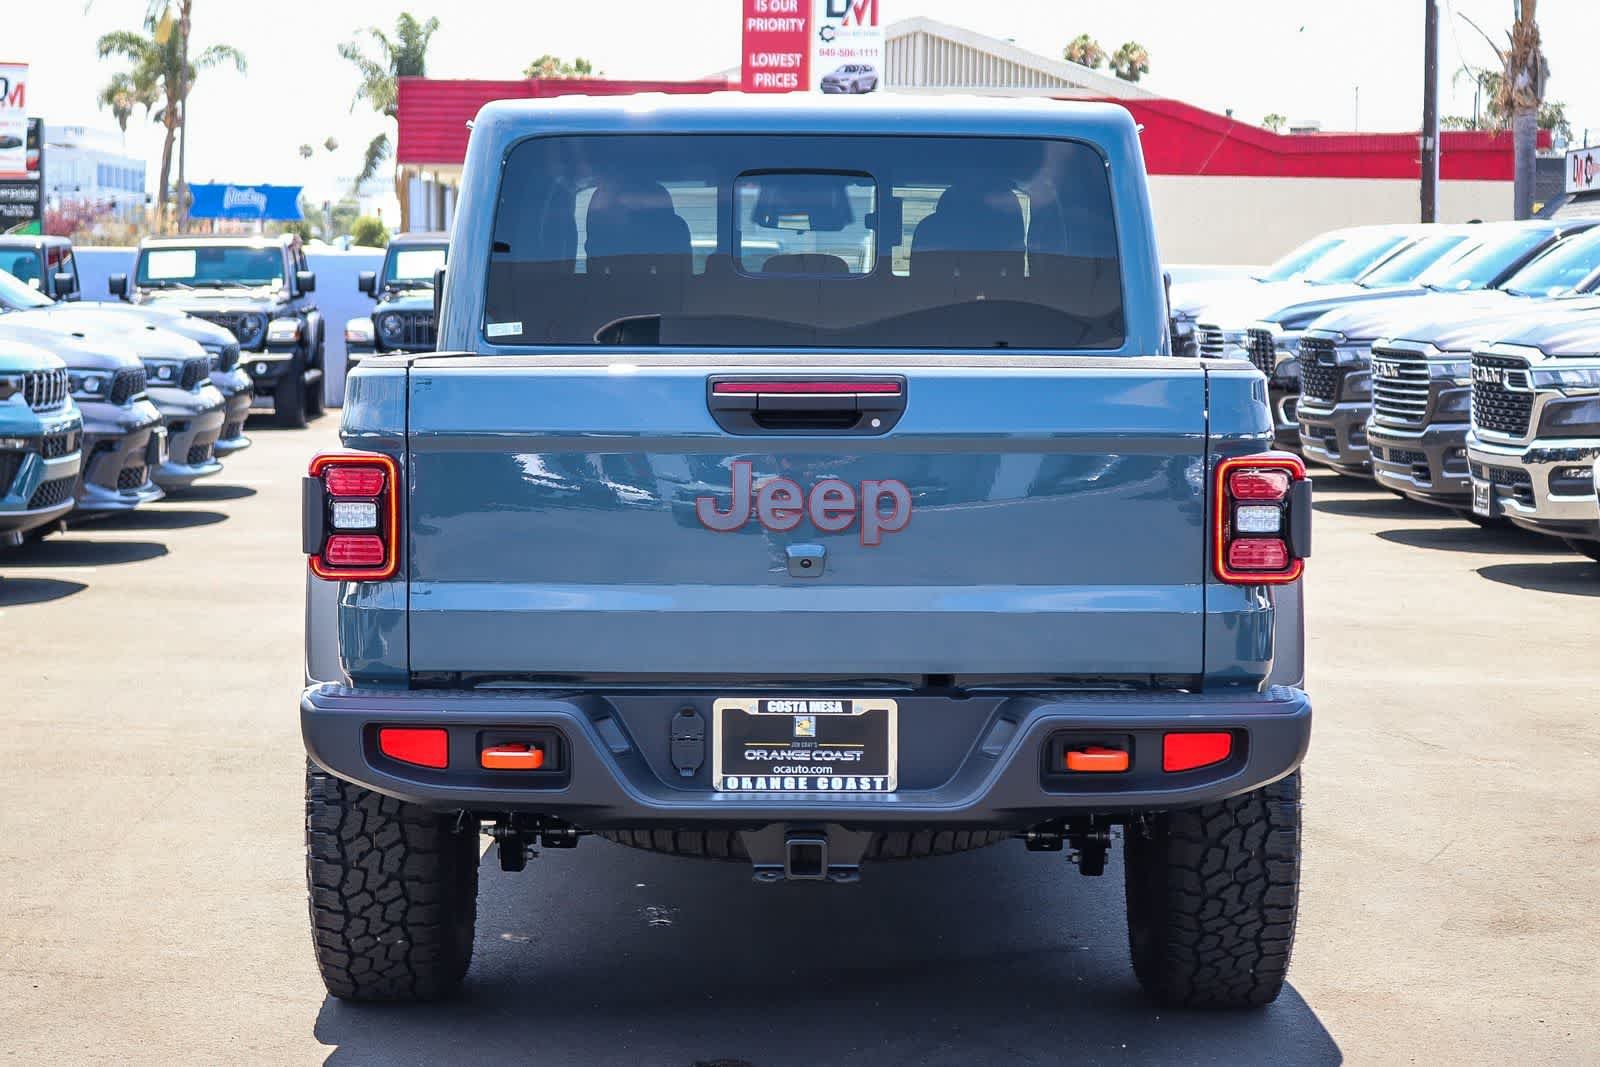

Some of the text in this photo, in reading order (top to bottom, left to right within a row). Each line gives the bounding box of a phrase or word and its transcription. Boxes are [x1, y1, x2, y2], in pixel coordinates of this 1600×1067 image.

[756, 0, 798, 13] IS OUR
[748, 18, 806, 31] PRIORITY
[751, 53, 802, 66] LOWEST
[755, 73, 798, 87] PRICES
[1471, 363, 1502, 384] RAM
[696, 460, 912, 547] Jeep
[767, 701, 843, 713] COSTA MESA
[744, 749, 864, 761] ORANGE COAST
[773, 765, 833, 774] ocauto.com
[726, 776, 884, 790] ORANGE COAST
